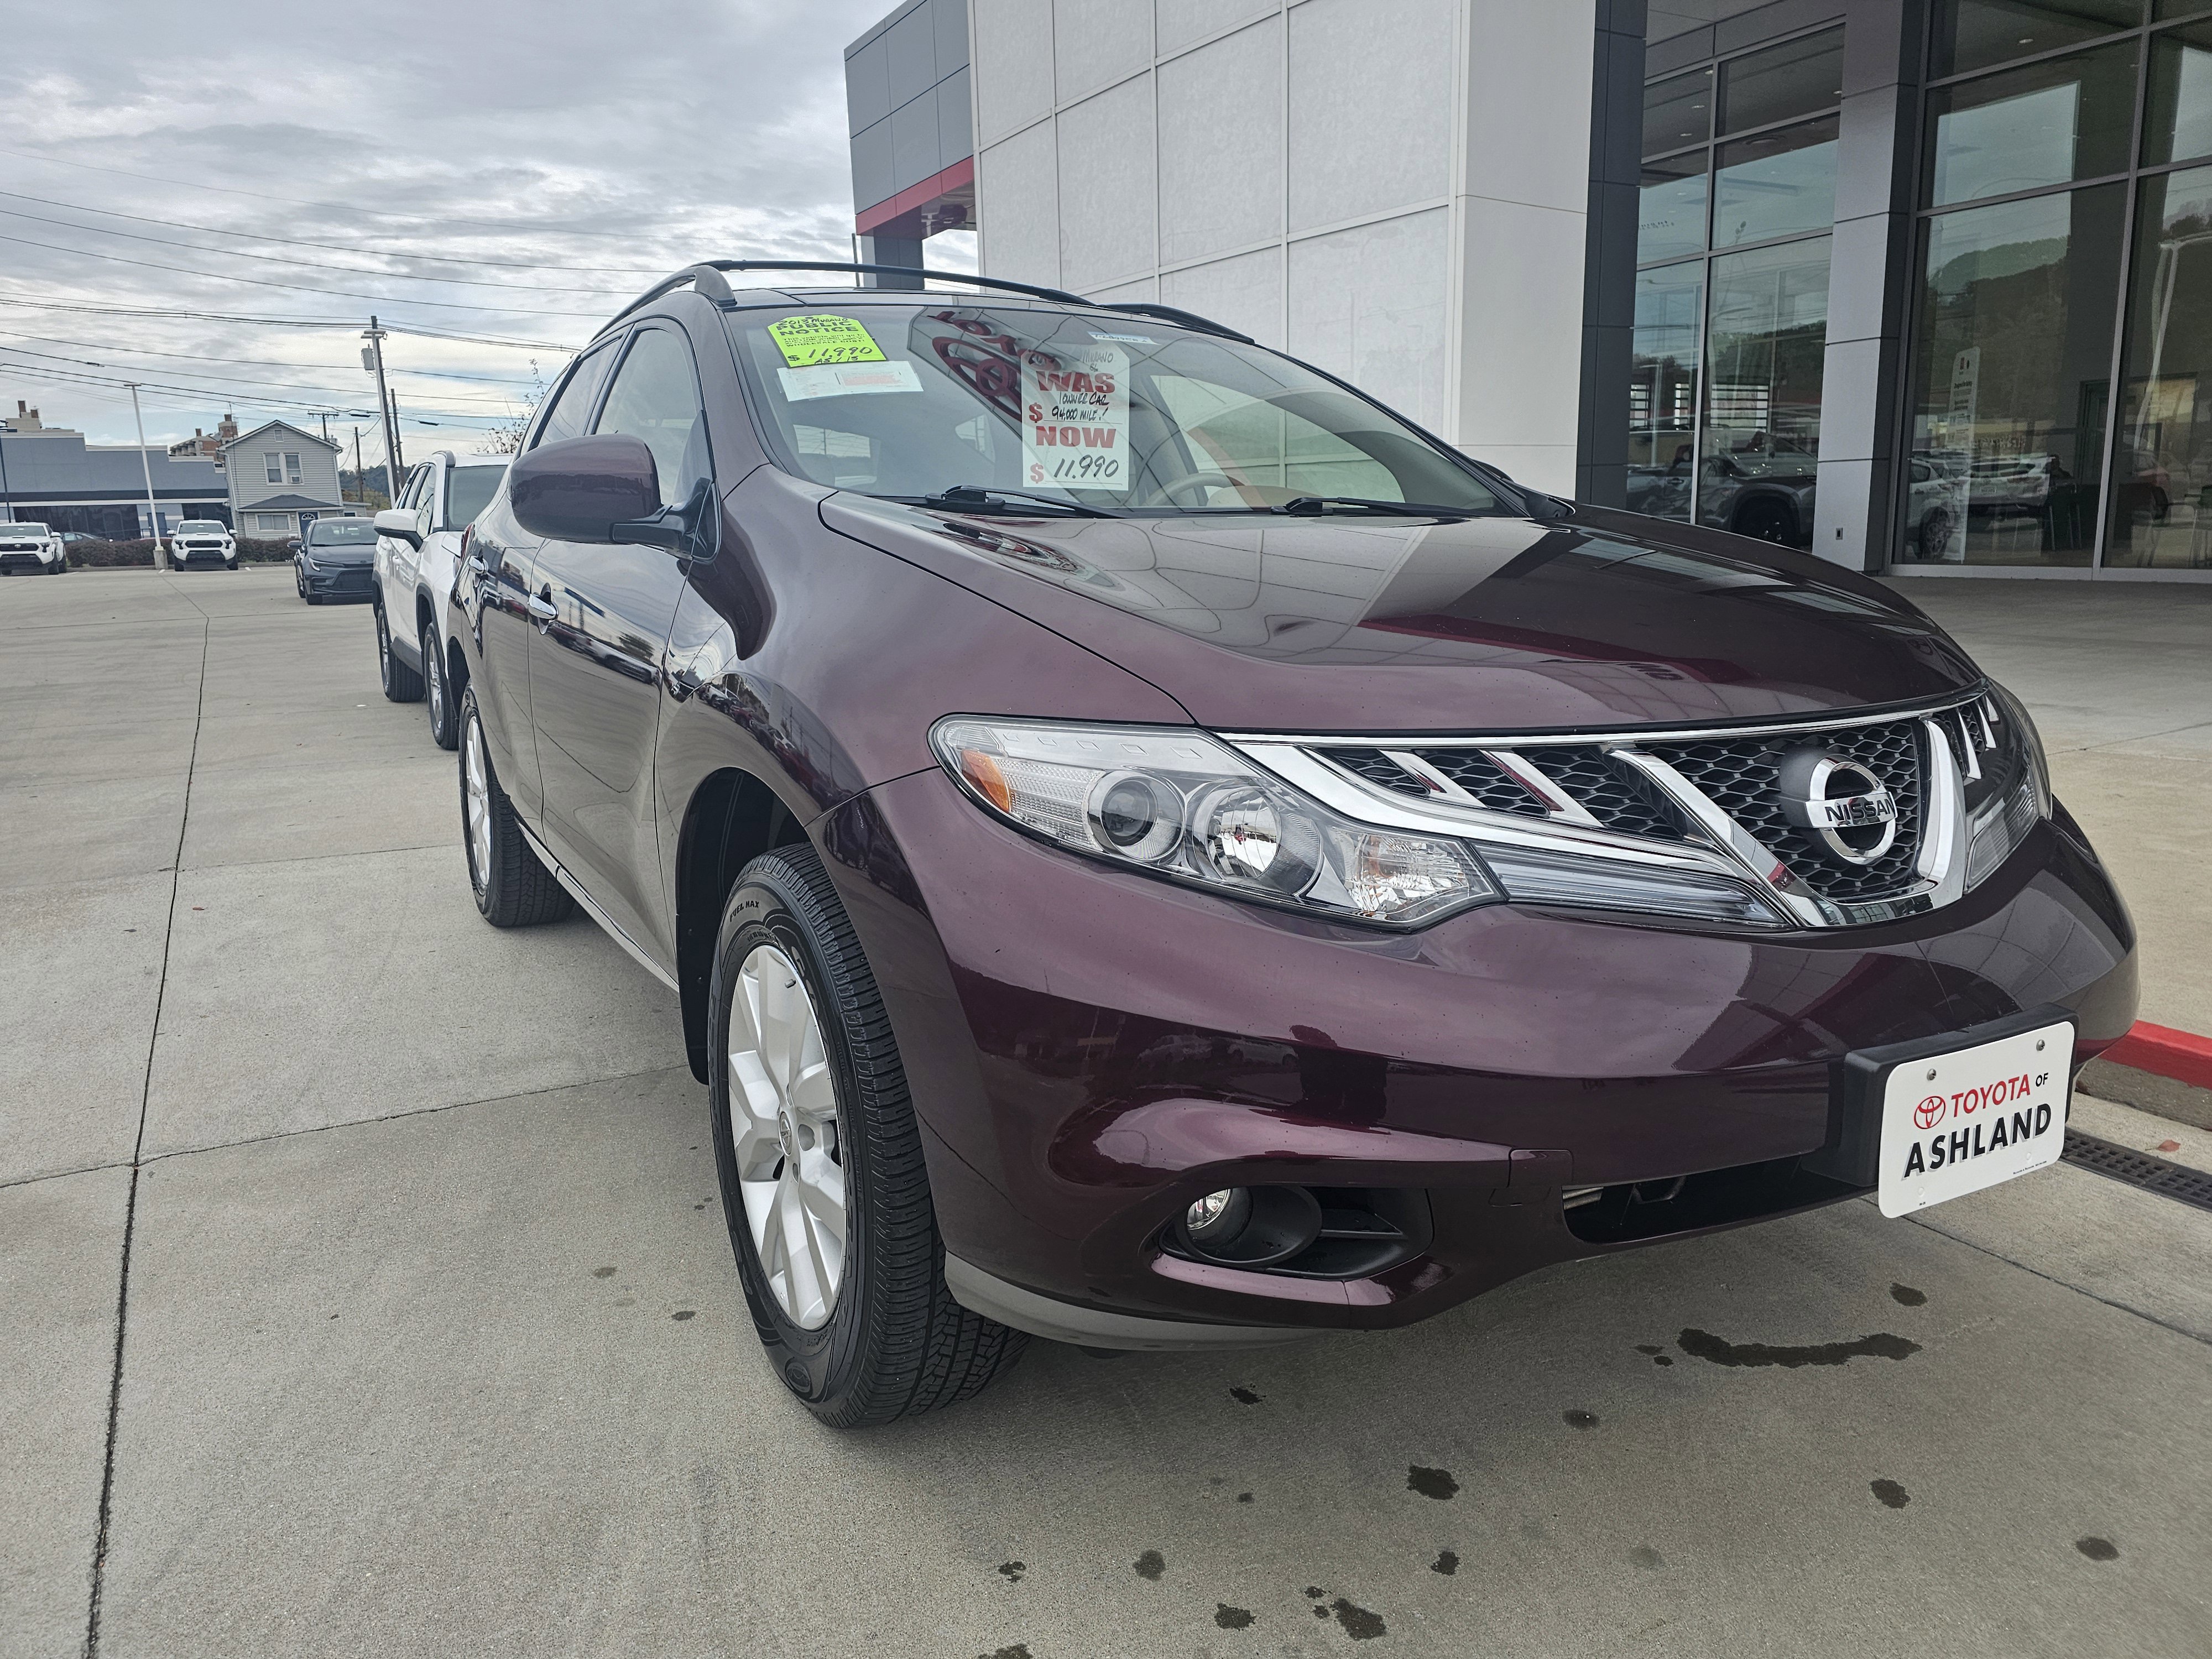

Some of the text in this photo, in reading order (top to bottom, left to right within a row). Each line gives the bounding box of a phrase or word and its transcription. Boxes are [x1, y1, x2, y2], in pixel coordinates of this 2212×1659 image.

[776, 321, 852, 330] PUBLIC
[780, 326, 858, 336] NOTICE
[1083, 349, 1113, 363] MURANO
[1036, 371, 1115, 393] WAS
[1089, 391, 1109, 405] CAR
[1036, 426, 1116, 448] NOW
[1824, 798, 1896, 822] NISSAN
[729, 900, 759, 922] FUEL MAX
[1951, 1072, 2048, 1118] TOYOTA OF
[1902, 1103, 2051, 1179] ASHLAND
